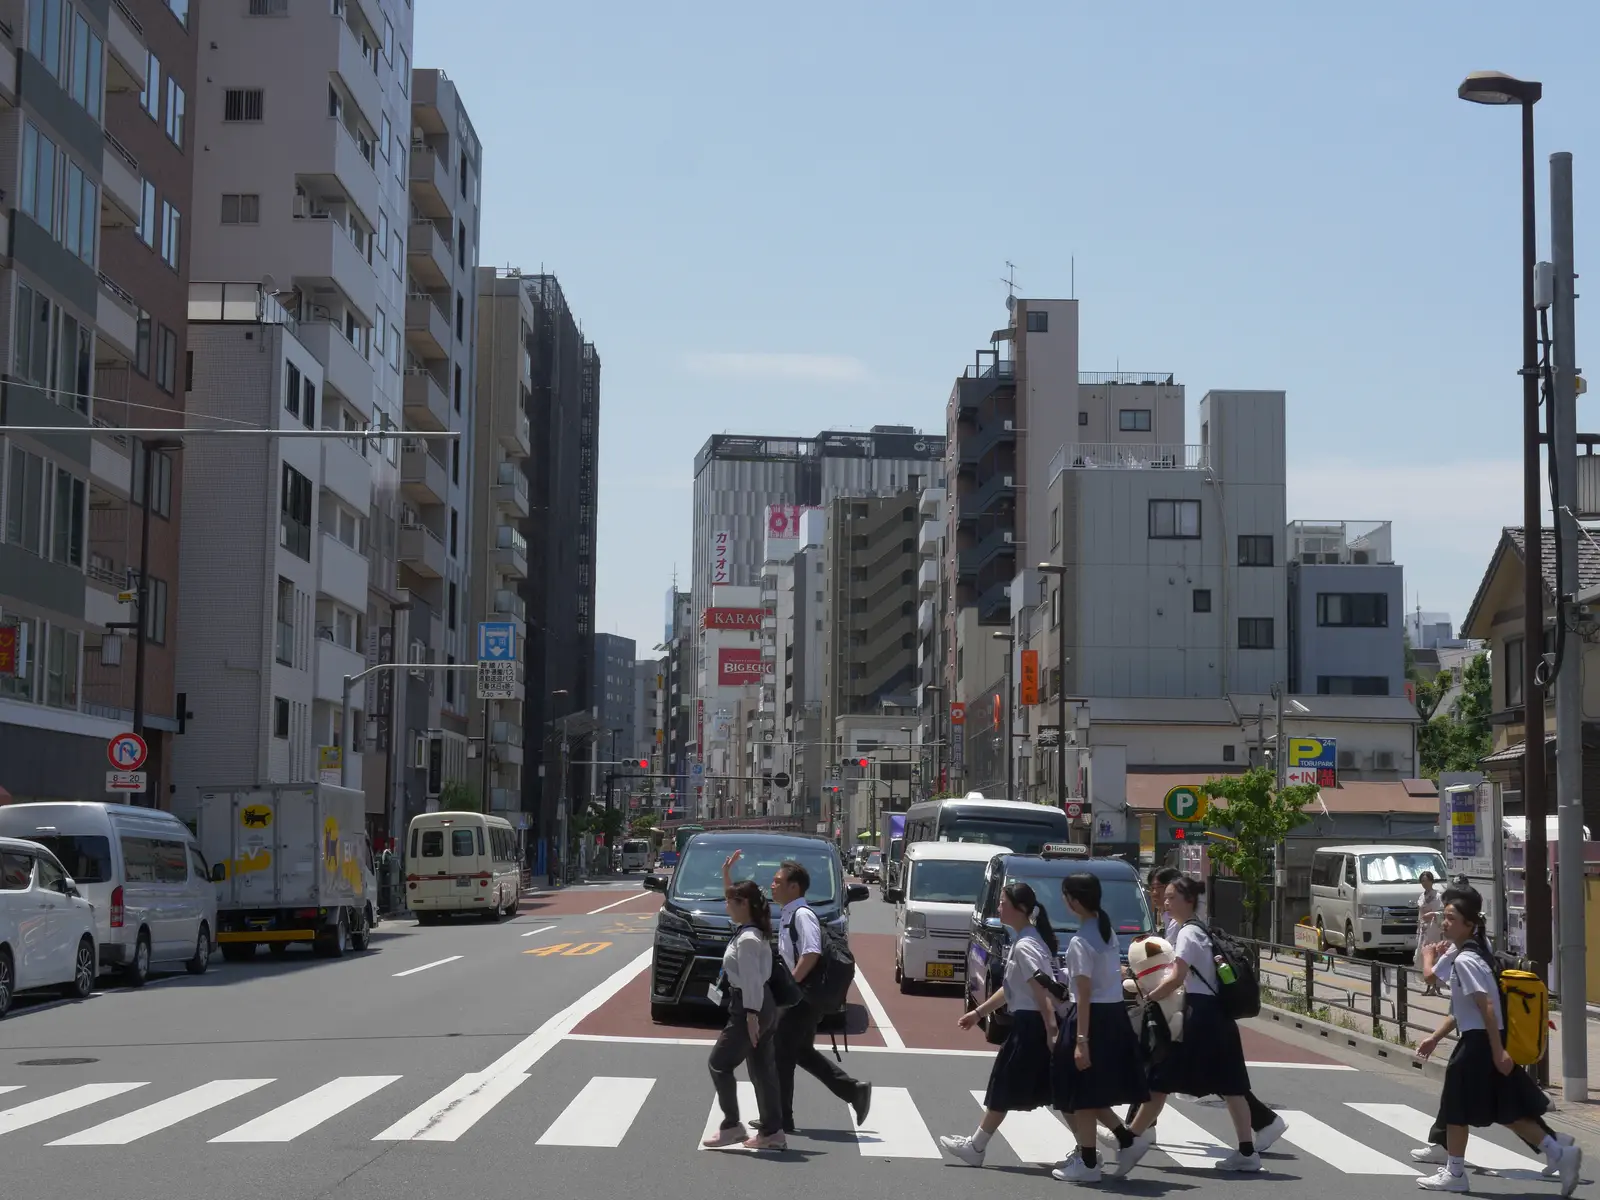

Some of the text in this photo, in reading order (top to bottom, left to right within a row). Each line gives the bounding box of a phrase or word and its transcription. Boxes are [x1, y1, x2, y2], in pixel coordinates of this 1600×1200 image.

[715, 532, 727, 582] カラオケ
[724, 663, 745, 673] BIG
[1289, 739, 1322, 766] P
[1301, 772, 1316, 783] IN
[1316, 768, 1335, 788] 満
[1176, 793, 1194, 816] P
[1051, 845, 1085, 853] Hinomaru
[521, 941, 613, 956] 40
